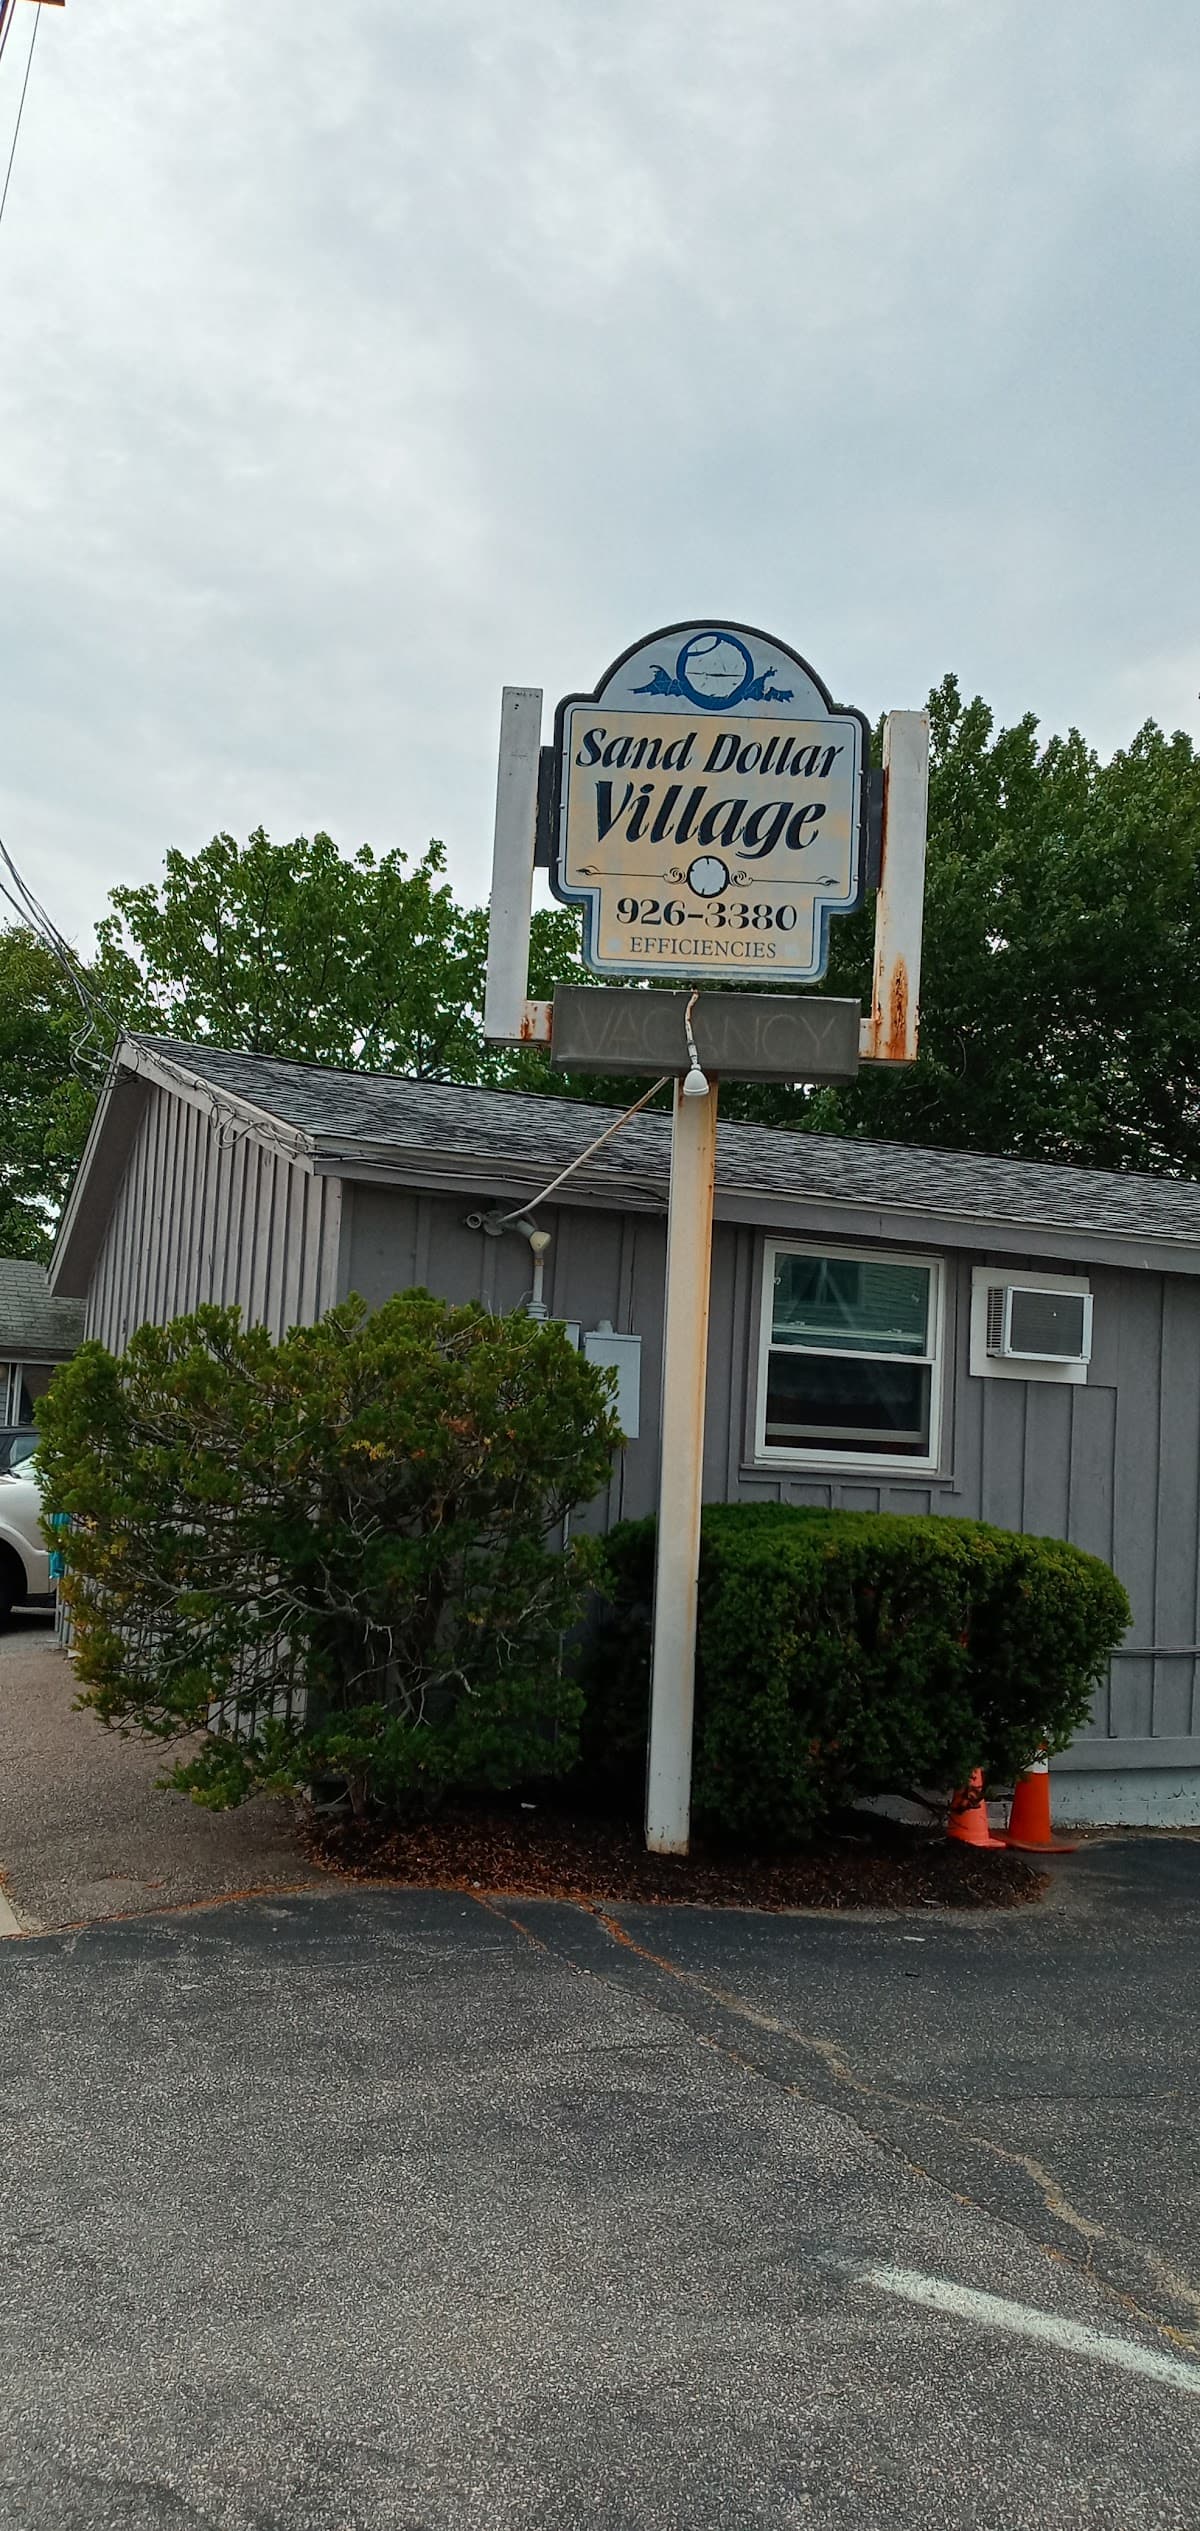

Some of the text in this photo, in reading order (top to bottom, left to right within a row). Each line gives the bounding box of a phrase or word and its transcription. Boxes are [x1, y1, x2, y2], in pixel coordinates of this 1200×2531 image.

[575, 727, 844, 778] Sand Dollar
[595, 780, 827, 859] Village
[616, 897, 798, 931] 926-3380
[630, 936, 777, 958] EFFICIENCIES
[576, 1003, 839, 1062] VACANCY
